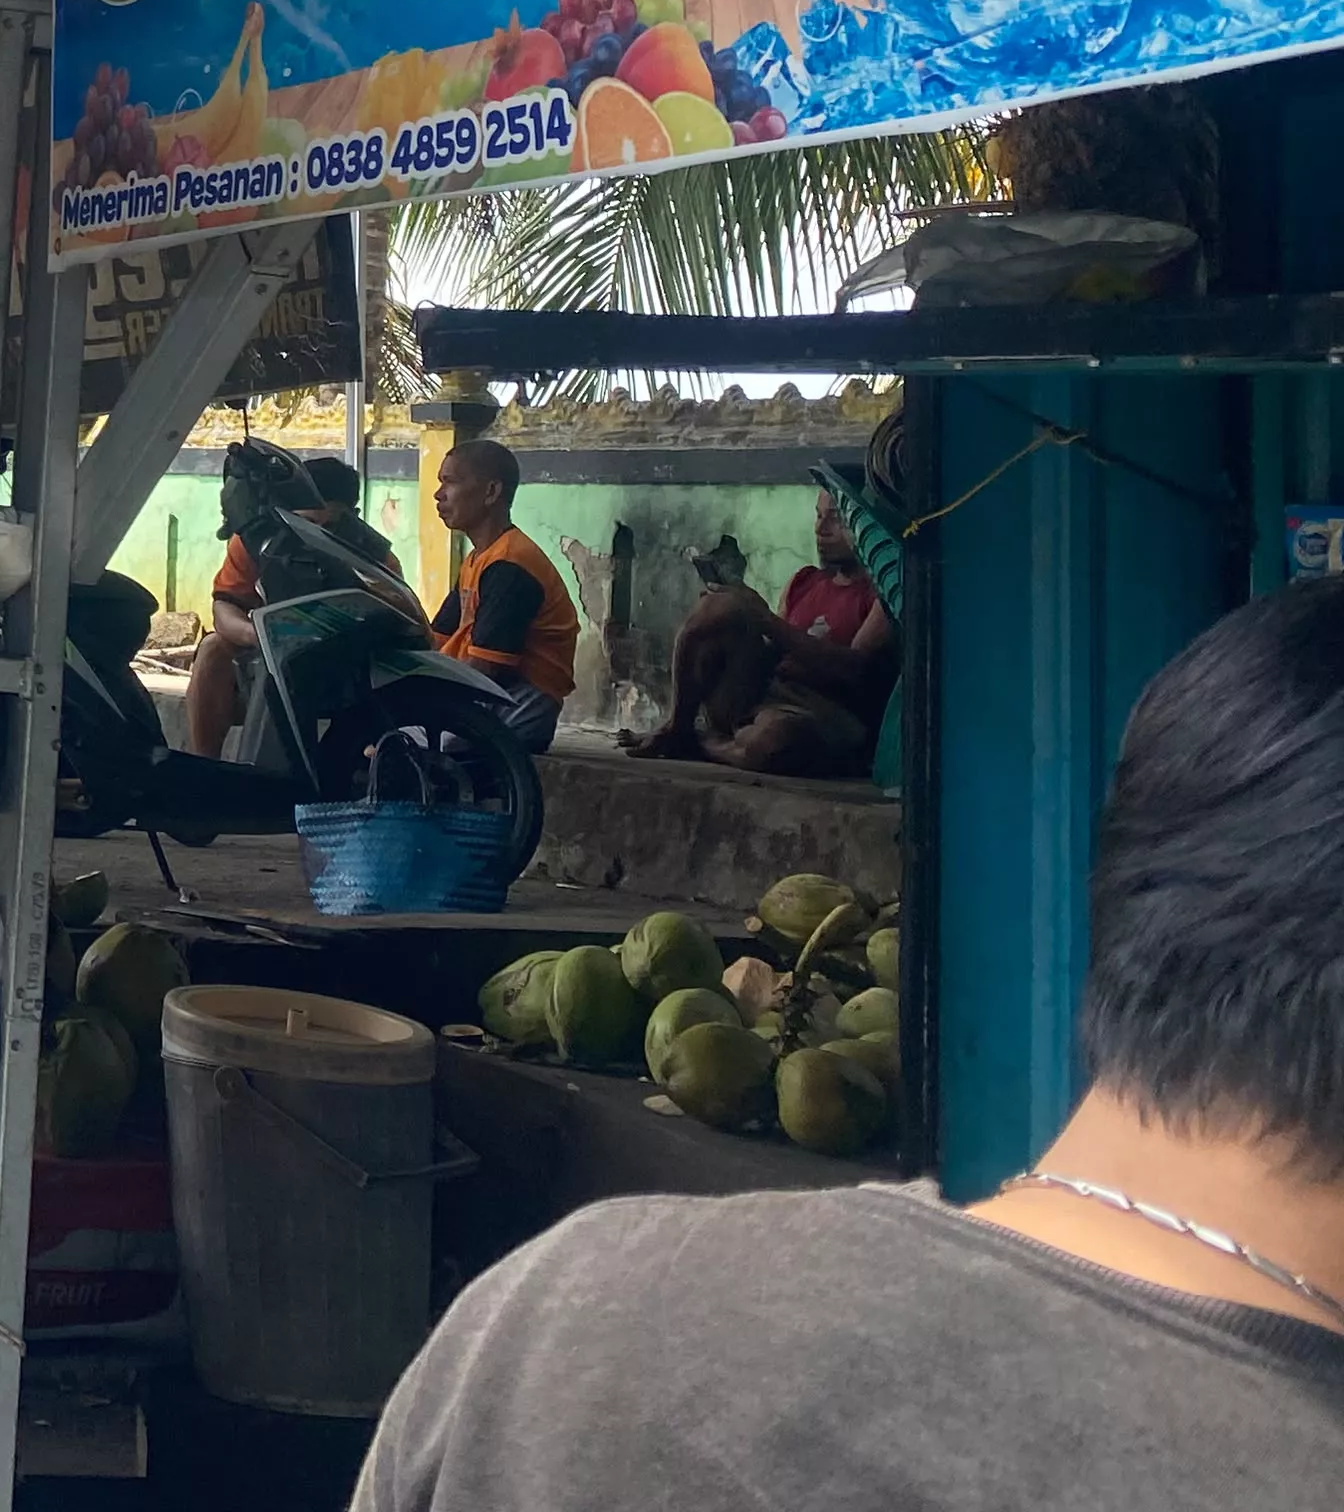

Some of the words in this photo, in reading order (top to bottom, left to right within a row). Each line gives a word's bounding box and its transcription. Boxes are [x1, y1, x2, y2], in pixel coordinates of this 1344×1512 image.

[63, 181, 167, 231] Menerima
[174, 161, 281, 214] Pesanan
[307, 134, 383, 190] 0838
[391, 116, 476, 175] 4859
[486, 97, 572, 159] 2514
